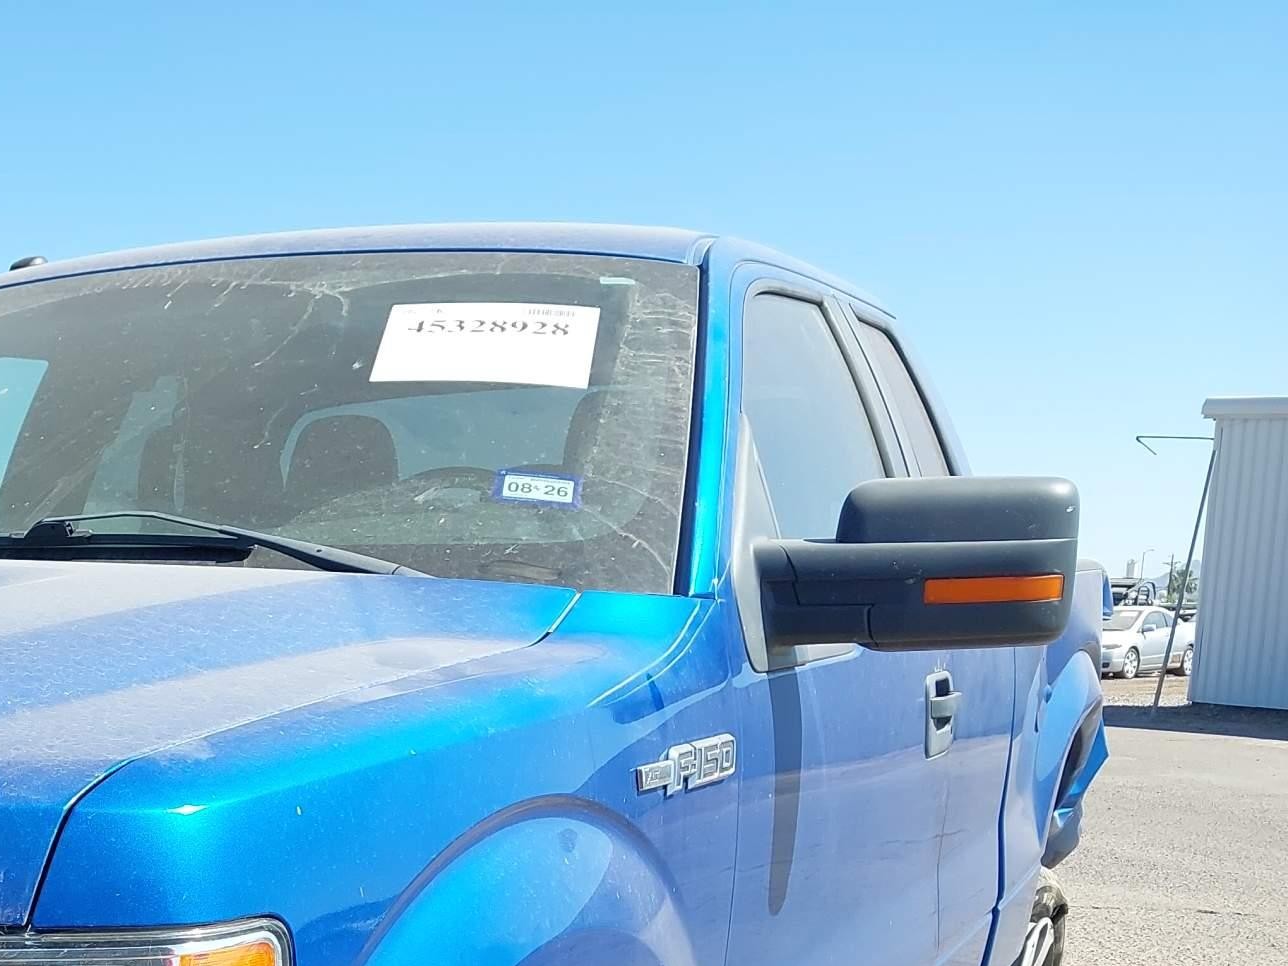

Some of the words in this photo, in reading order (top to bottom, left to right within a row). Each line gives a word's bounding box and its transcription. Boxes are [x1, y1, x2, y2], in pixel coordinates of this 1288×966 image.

[407, 319, 570, 336] 45328928
[507, 481, 533, 494] 08
[543, 484, 569, 497] 26
